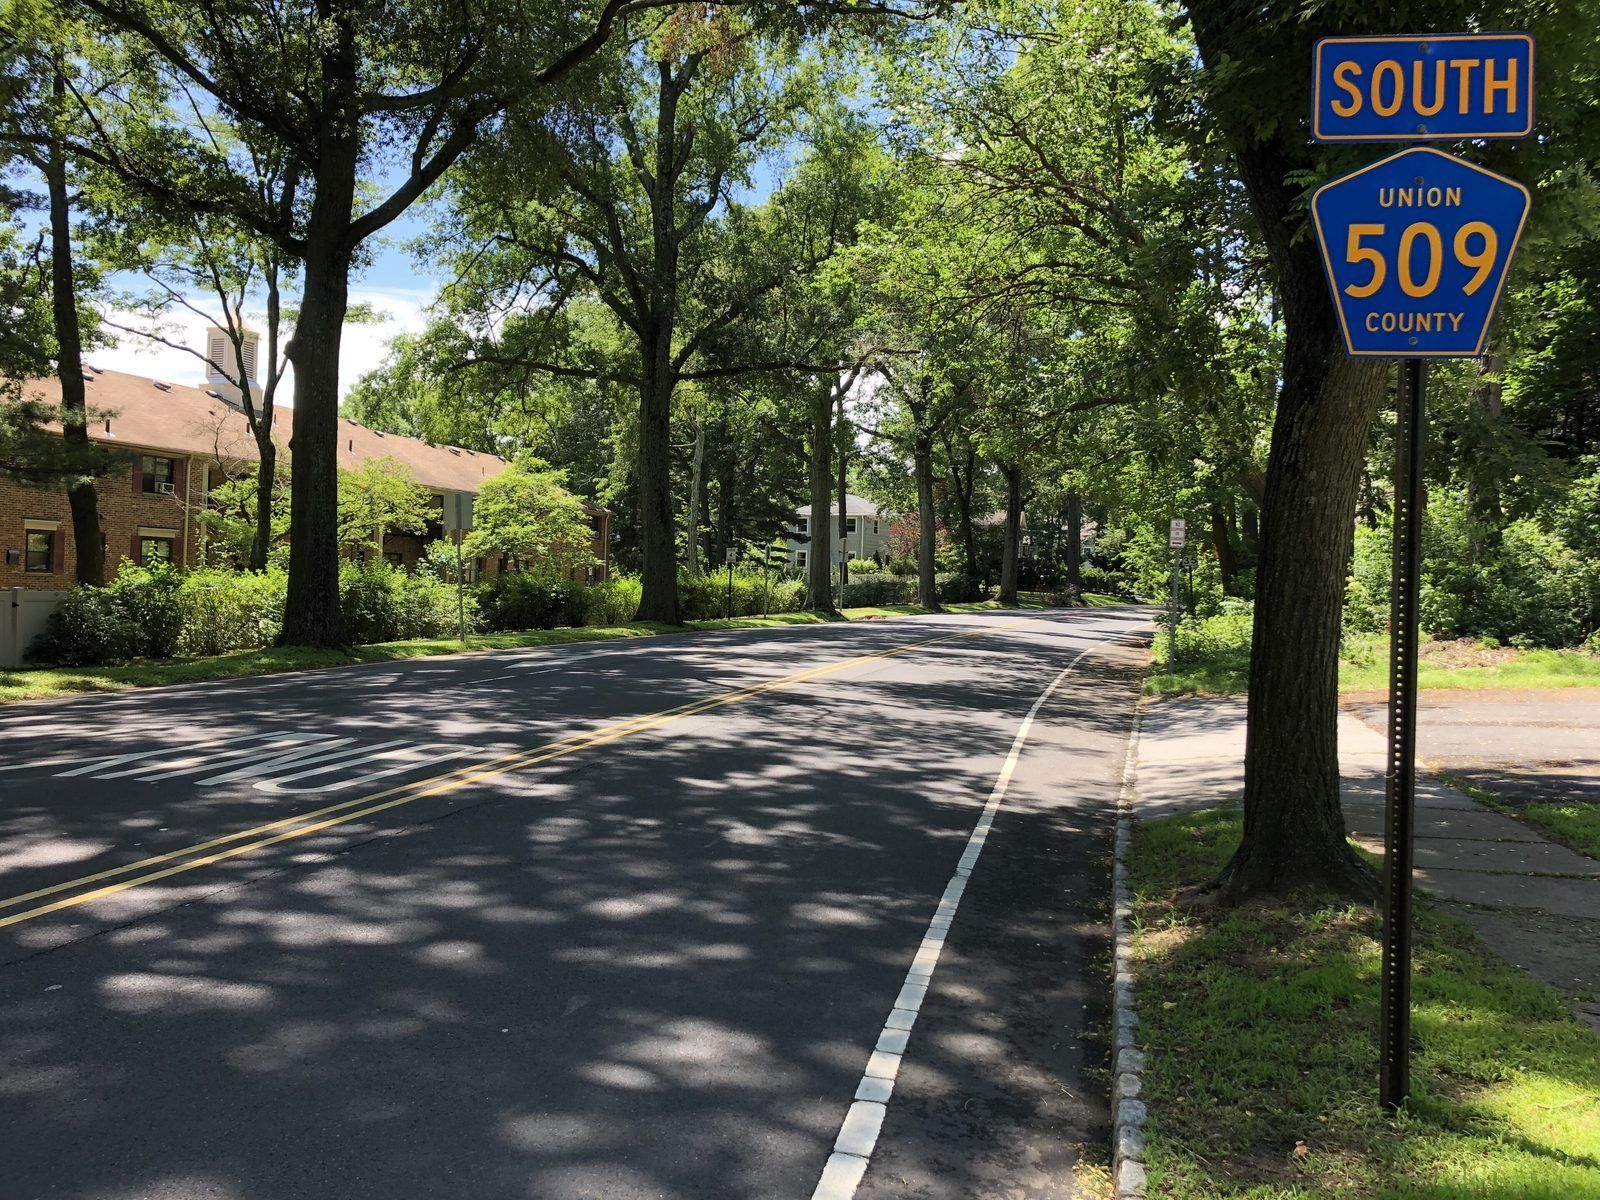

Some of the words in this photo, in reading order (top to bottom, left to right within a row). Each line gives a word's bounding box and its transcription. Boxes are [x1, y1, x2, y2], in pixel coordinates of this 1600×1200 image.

[1331, 58, 1517, 117] SOUTH
[1379, 187, 1462, 208] UNION
[1344, 221, 1498, 298] 509
[1365, 312, 1464, 332] COUNTY
